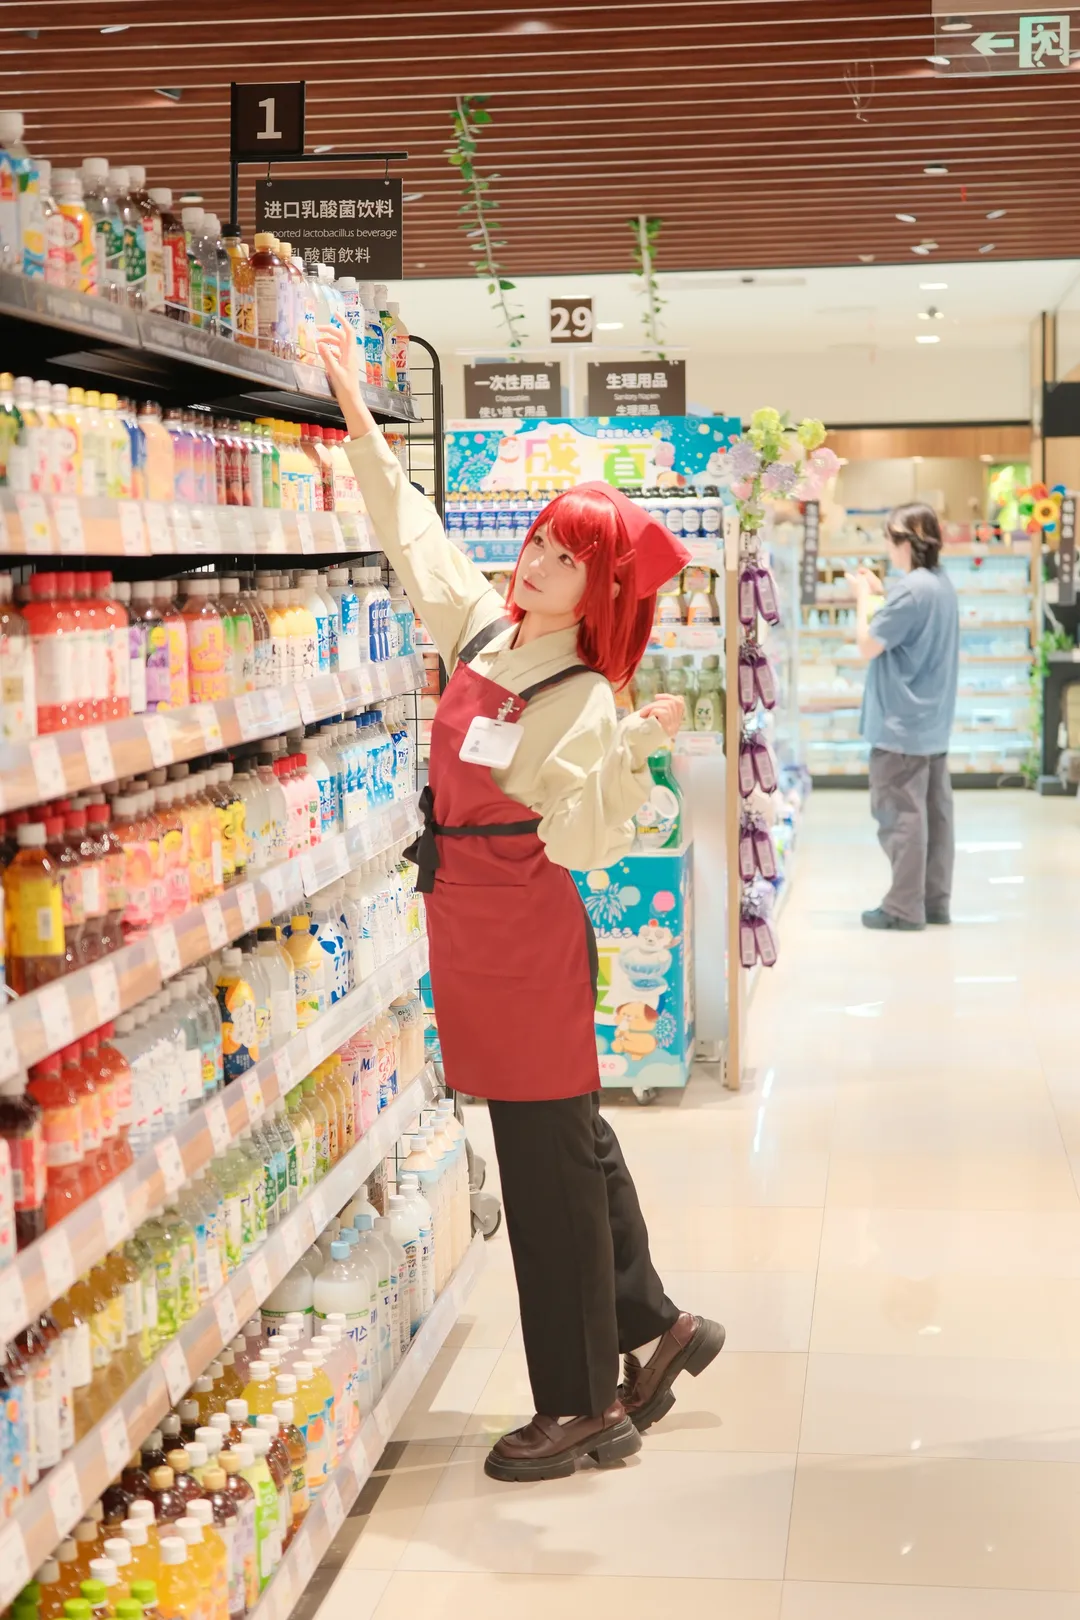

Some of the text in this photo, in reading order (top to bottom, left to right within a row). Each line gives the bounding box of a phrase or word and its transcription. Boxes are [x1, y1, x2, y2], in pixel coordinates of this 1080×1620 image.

[257, 98, 282, 139] 1
[264, 199, 394, 219] 进口乳酸菌饮料
[303, 229, 354, 238] lactobacillus
[356, 229, 397, 240] beverage
[550, 306, 592, 338] 29
[474, 374, 550, 390] 一次性用品
[606, 373, 668, 389] 生理用品
